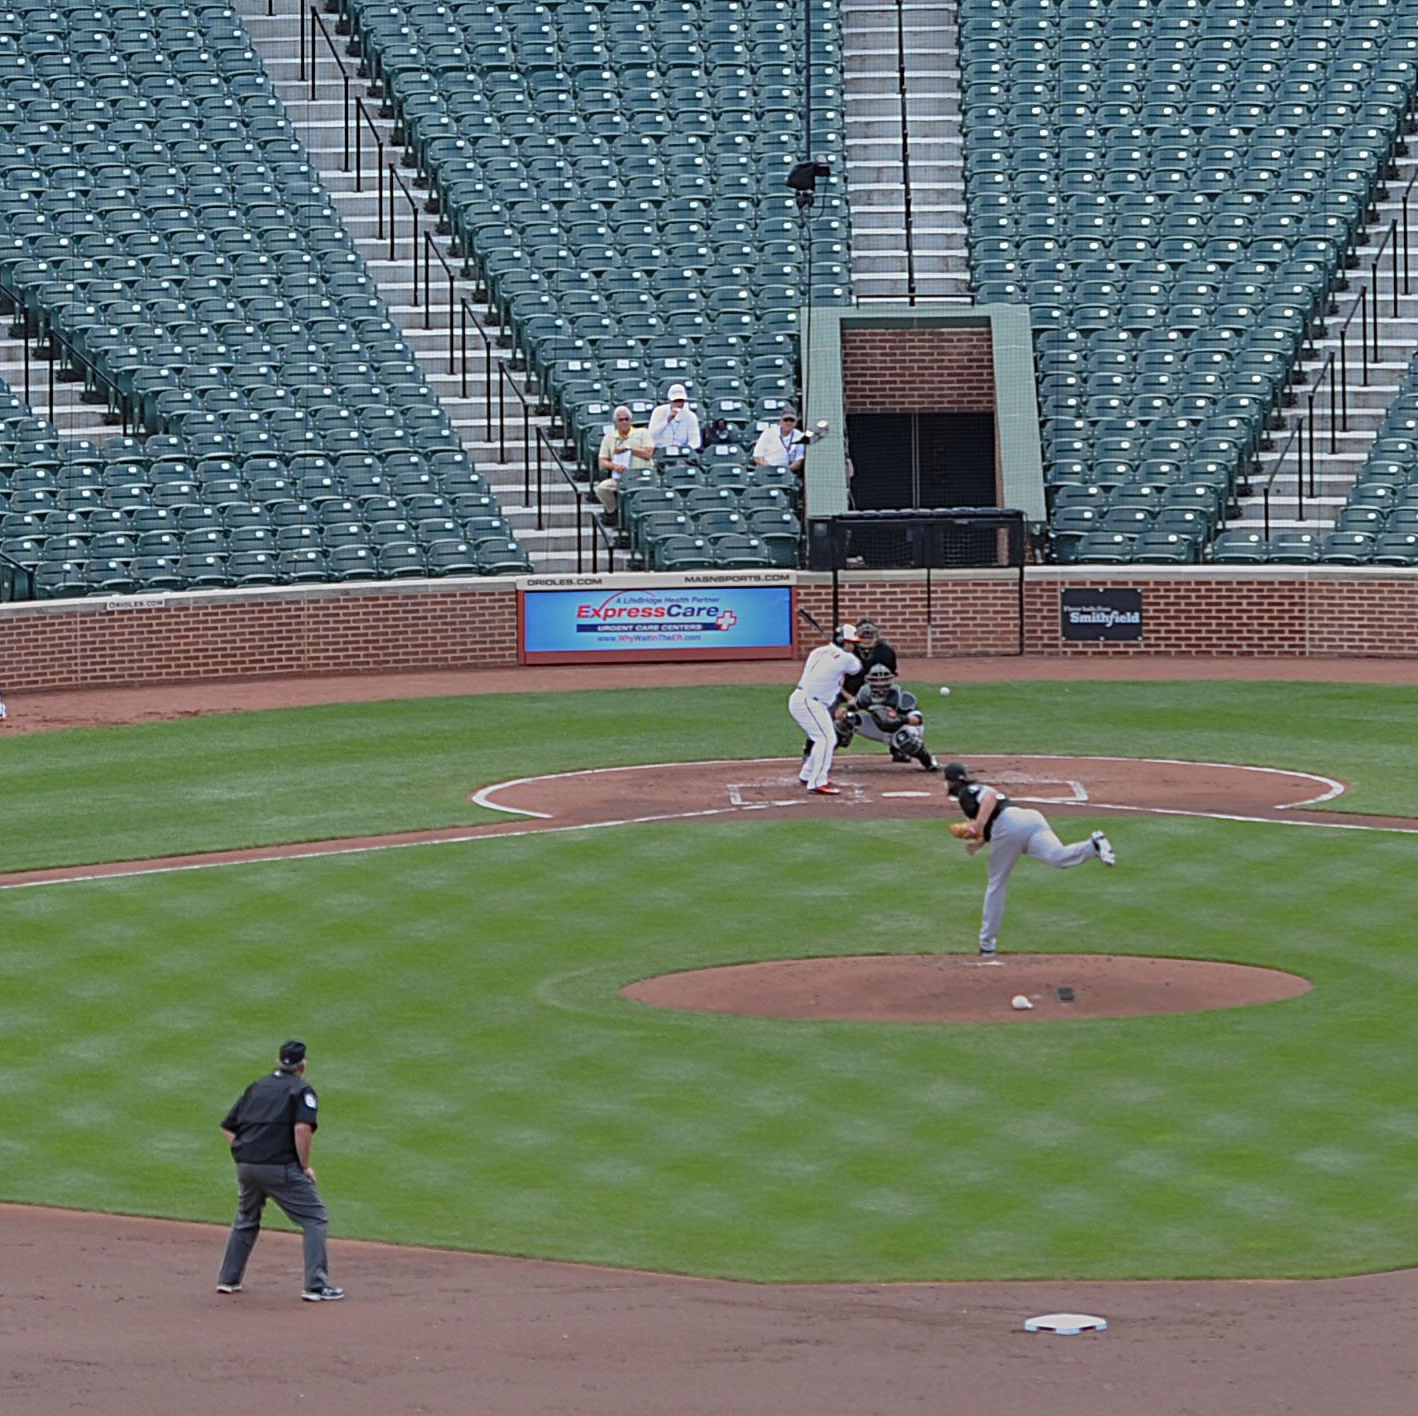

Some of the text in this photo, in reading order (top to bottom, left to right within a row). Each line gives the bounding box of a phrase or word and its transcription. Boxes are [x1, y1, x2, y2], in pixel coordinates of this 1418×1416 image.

[527, 578, 602, 587] ORIOLES.COM
[684, 573, 790, 584] MASNSPORTS.COM
[664, 596, 690, 604] Health
[576, 603, 719, 620] ExpressCare
[1069, 610, 1140, 627] Smithfield
[597, 624, 632, 632] URGENT
[661, 623, 702, 631] CENTERS
